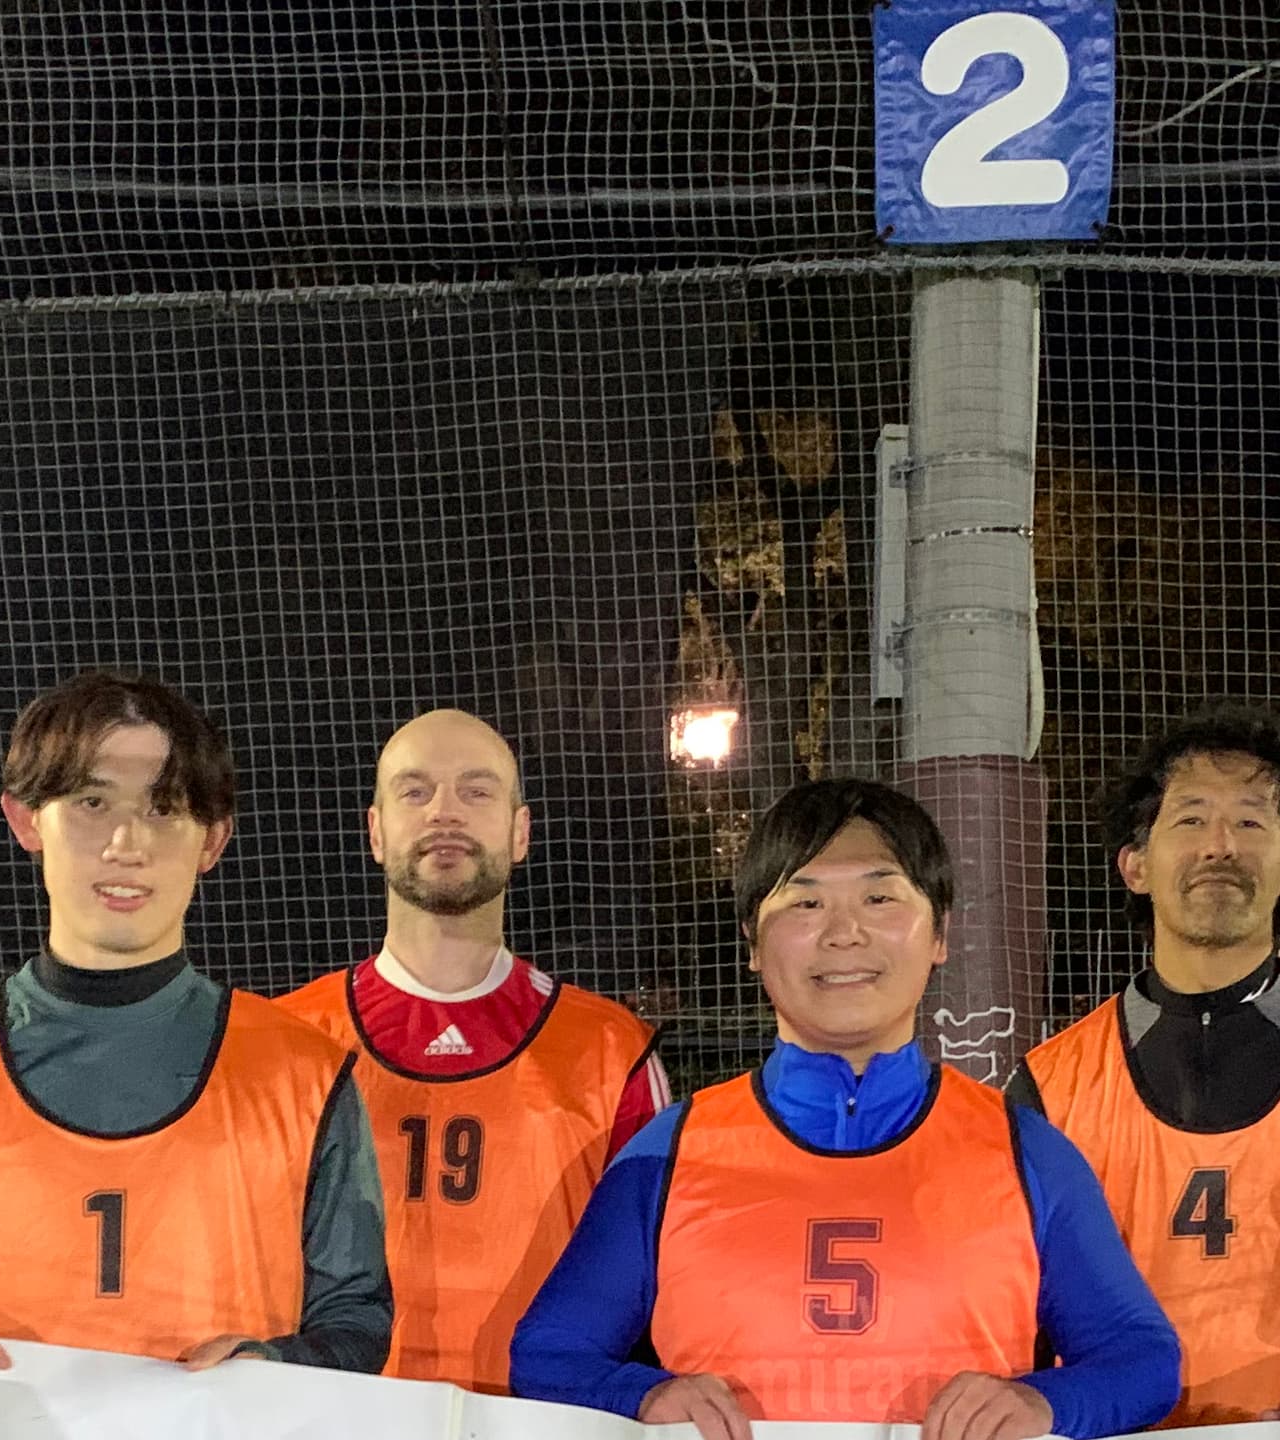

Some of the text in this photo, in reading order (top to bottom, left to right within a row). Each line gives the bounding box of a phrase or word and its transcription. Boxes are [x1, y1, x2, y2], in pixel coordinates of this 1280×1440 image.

[921, 11, 1069, 208] 2
[398, 1114, 485, 1205] 19
[1167, 1165, 1238, 1259] 4
[82, 1189, 128, 1299] 1
[802, 1217, 883, 1335] 5
